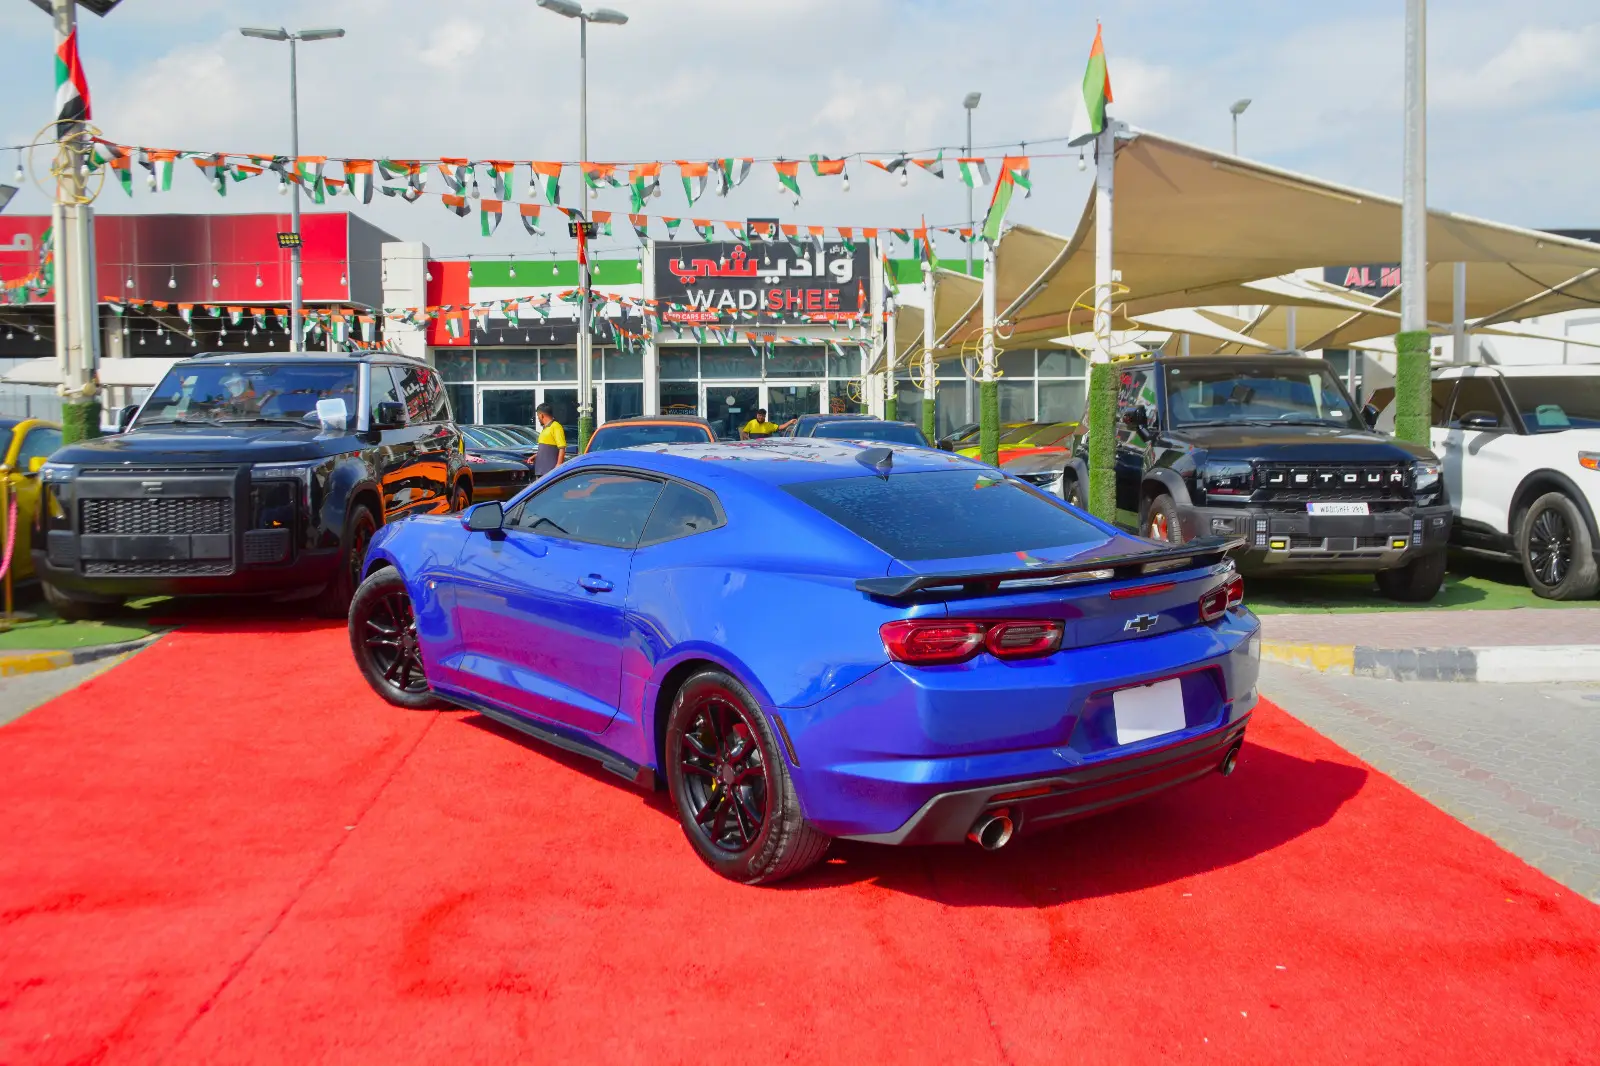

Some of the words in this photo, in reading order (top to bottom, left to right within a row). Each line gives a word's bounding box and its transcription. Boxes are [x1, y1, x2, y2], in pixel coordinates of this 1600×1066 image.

[750, 222, 777, 237] 29
[1344, 267, 1376, 287] AL
[1270, 474, 1402, 482] JETOUR
